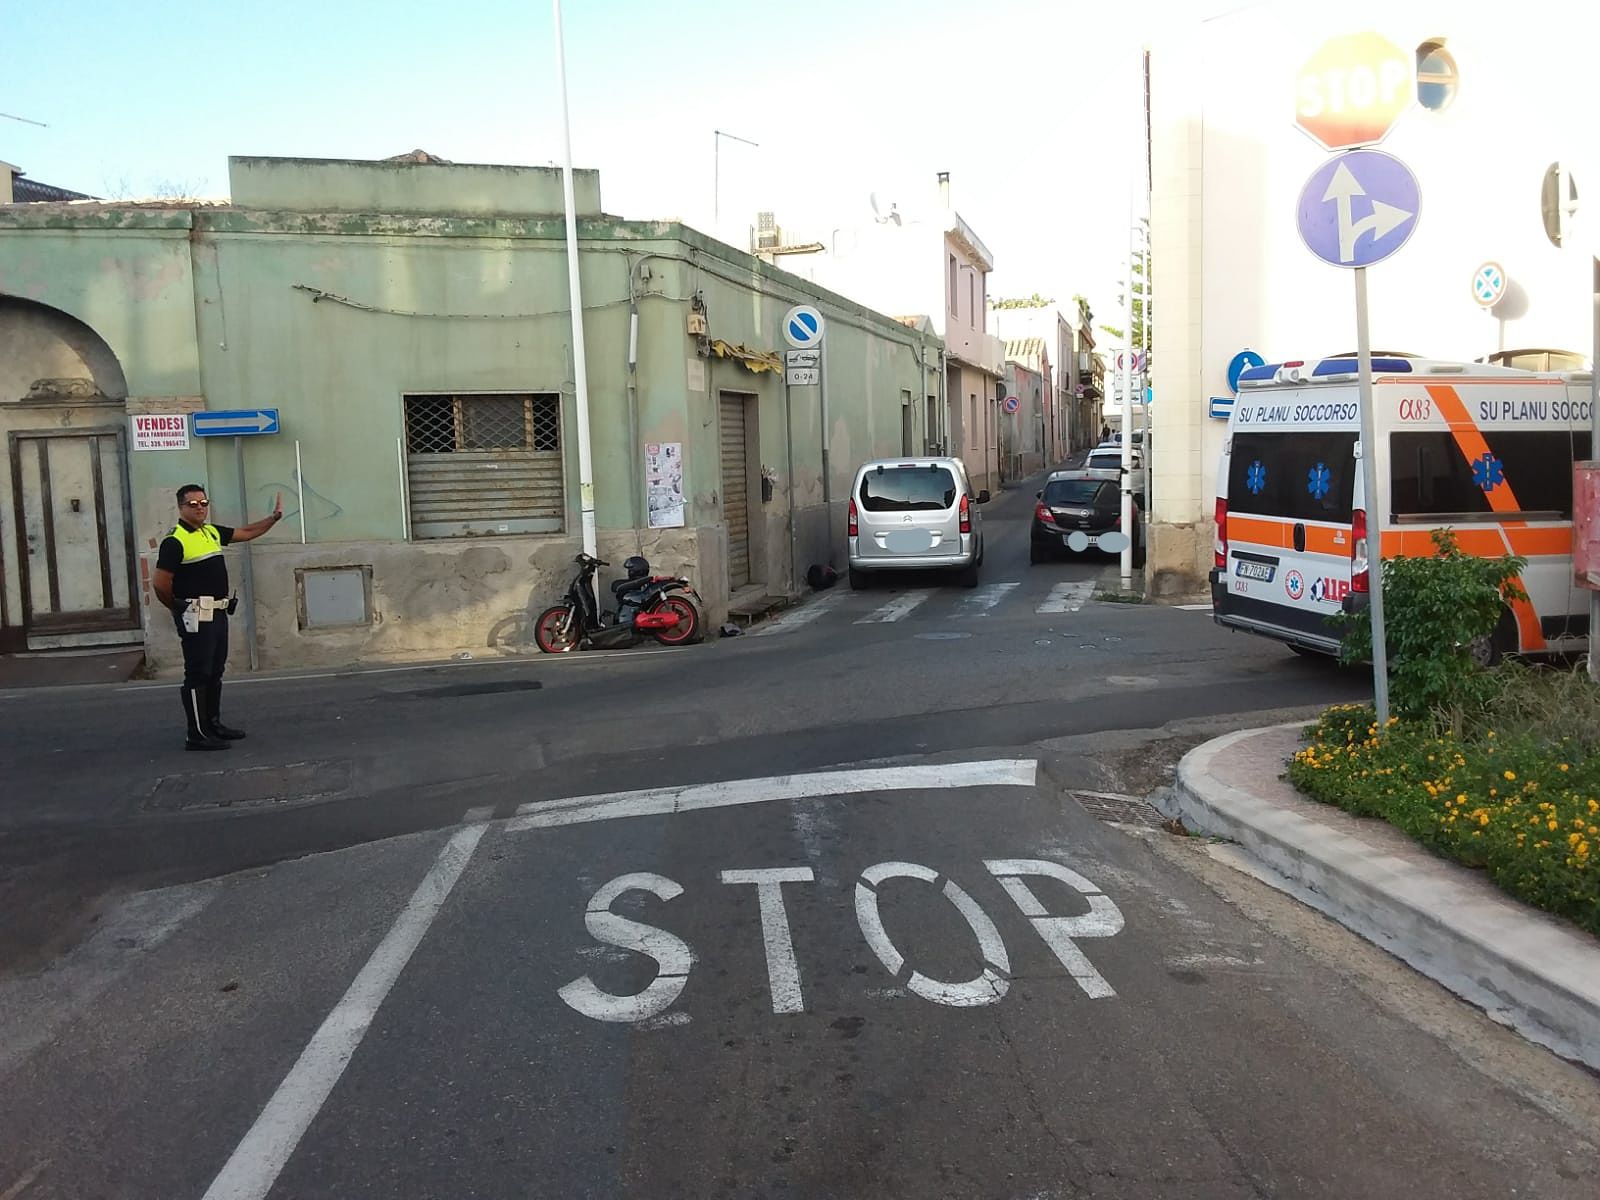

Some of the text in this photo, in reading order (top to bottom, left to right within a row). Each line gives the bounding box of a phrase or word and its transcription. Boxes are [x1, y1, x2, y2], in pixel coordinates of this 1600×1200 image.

[1299, 58, 1405, 118] STOP
[1239, 403, 1357, 422] SU PLANU SOCCORSO
[1480, 401, 1593, 421] SU PLANU SOCC
[136, 417, 184, 430] VENDESI
[557, 859, 1126, 1023] STOP
